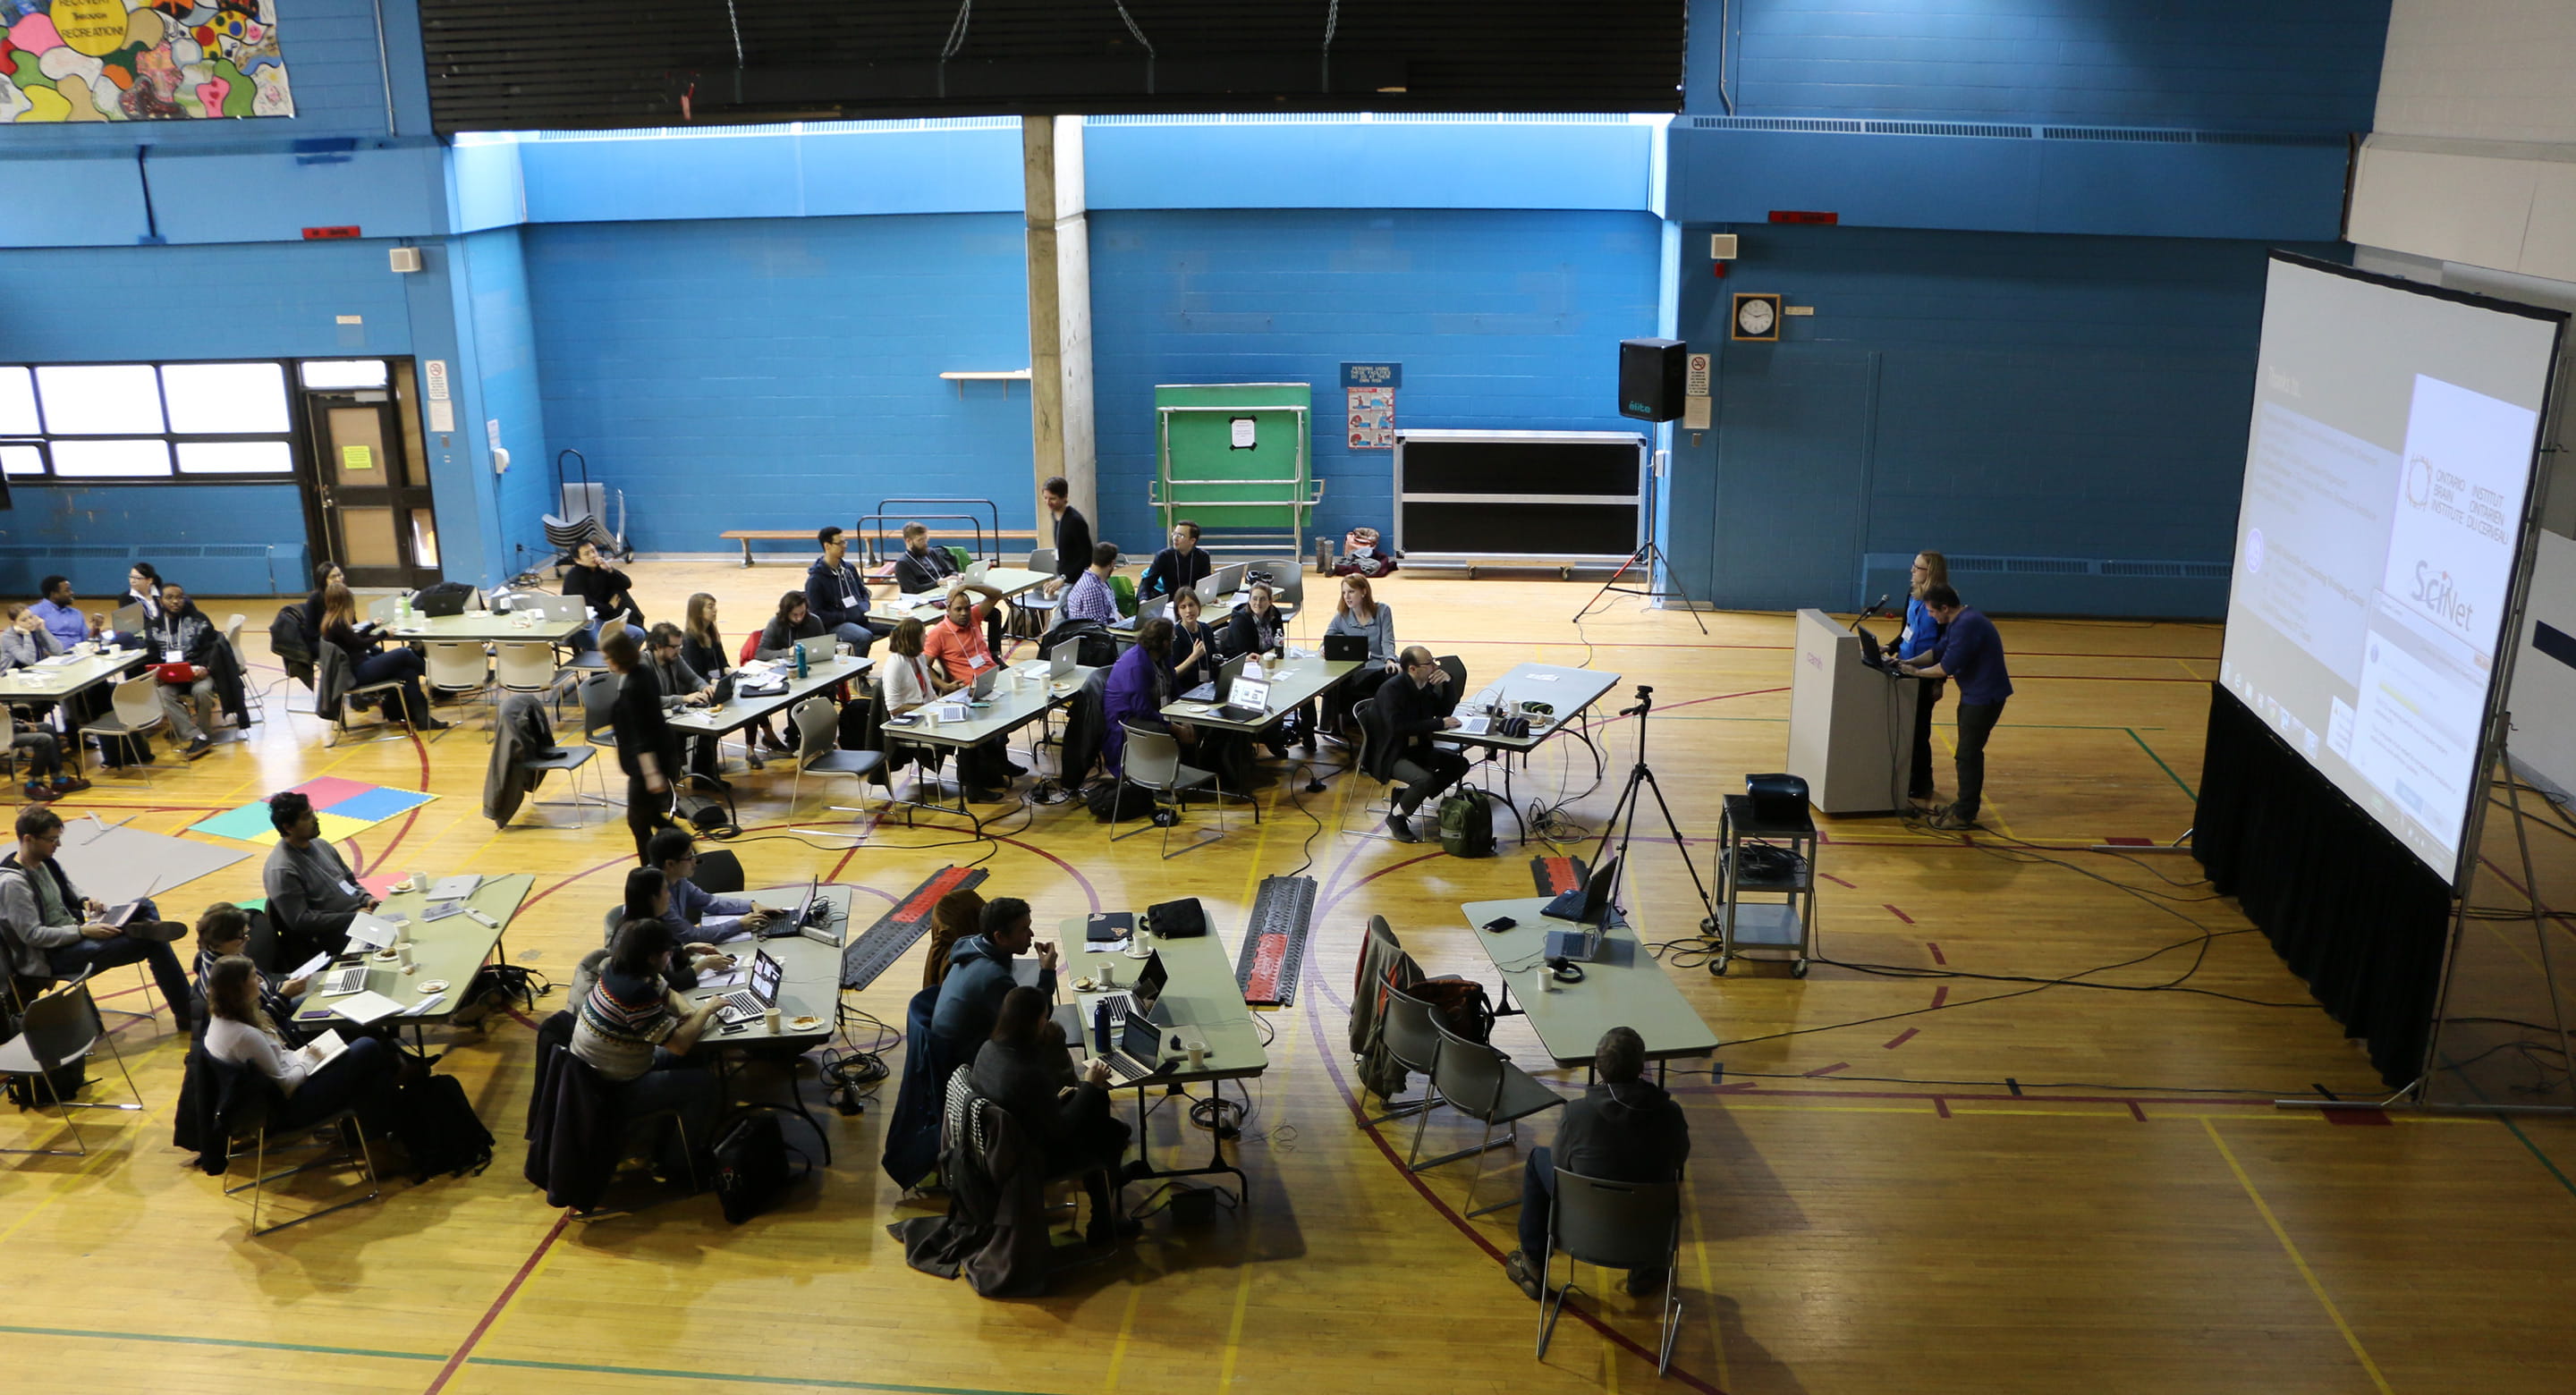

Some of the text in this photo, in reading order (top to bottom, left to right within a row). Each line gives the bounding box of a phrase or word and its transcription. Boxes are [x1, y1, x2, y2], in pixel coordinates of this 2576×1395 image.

[2433, 484, 2505, 526] BRAIN ONTARIEN
[2436, 469, 2504, 508] ONTARIO INSTITUT
[2431, 499, 2510, 545] INSTITUTE DU CERVEAU
[2411, 560, 2473, 631] SciNet
